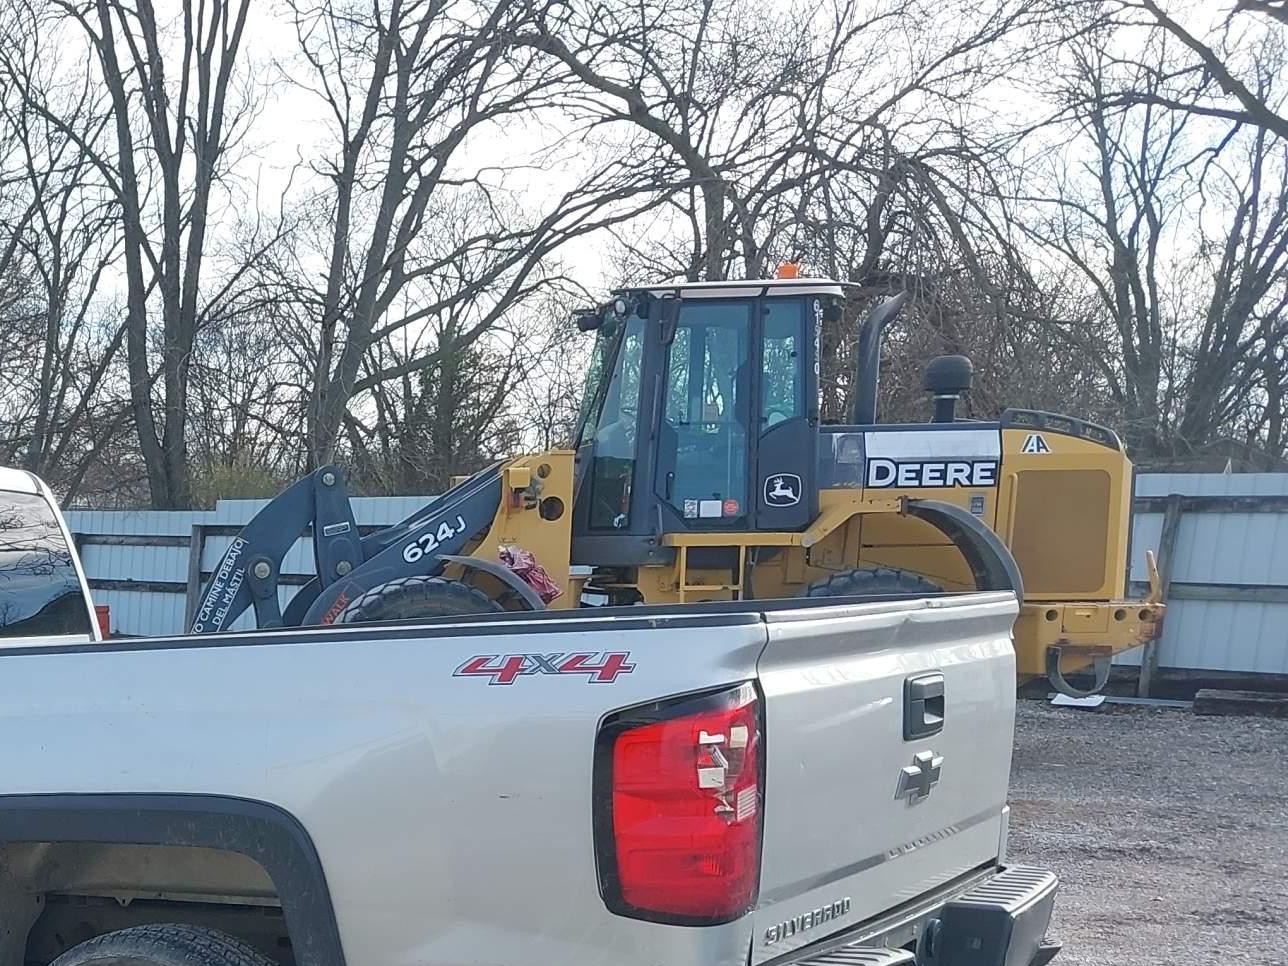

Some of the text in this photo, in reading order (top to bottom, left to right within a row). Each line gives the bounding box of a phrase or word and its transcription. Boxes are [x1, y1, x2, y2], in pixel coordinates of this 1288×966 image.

[868, 459, 996, 487] DEERE
[403, 515, 466, 563] 624J
[200, 579, 225, 621] CAMINE
[220, 540, 244, 579] DEBAJO
[212, 567, 245, 626] DEL MÁSTIL
[765, 896, 852, 946] SILVERADO
